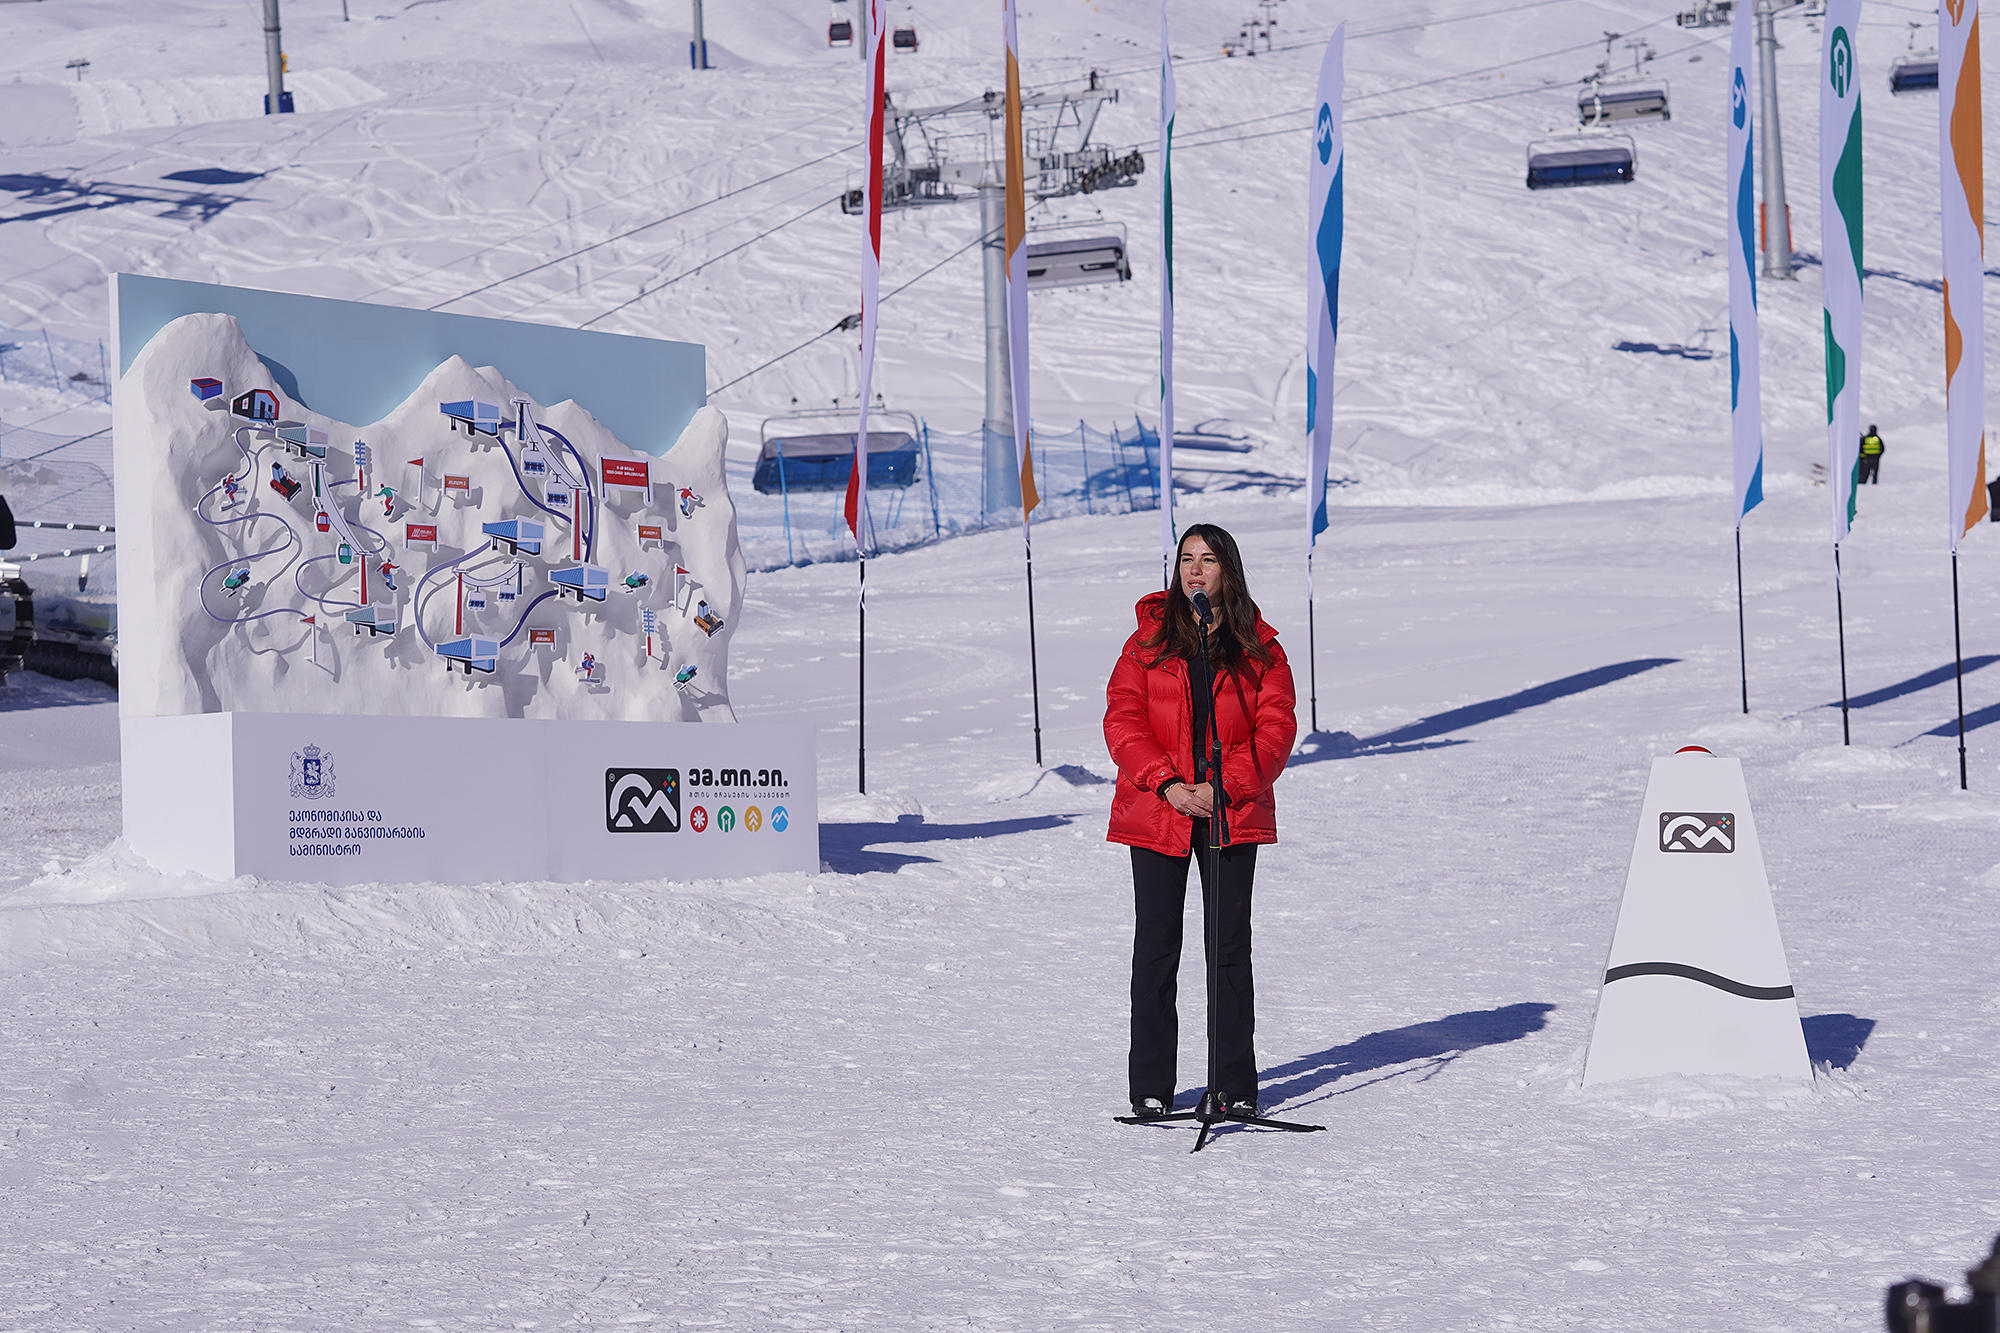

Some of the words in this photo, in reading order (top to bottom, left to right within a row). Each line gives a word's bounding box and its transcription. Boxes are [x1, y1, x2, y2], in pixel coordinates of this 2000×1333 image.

[289, 810, 364, 822] ეკონომიკისა
[367, 810, 382, 822] და
[289, 827, 342, 839] მდგრადი
[345, 827, 425, 839] განვითარების
[289, 844, 361, 856] სამინისტრო
